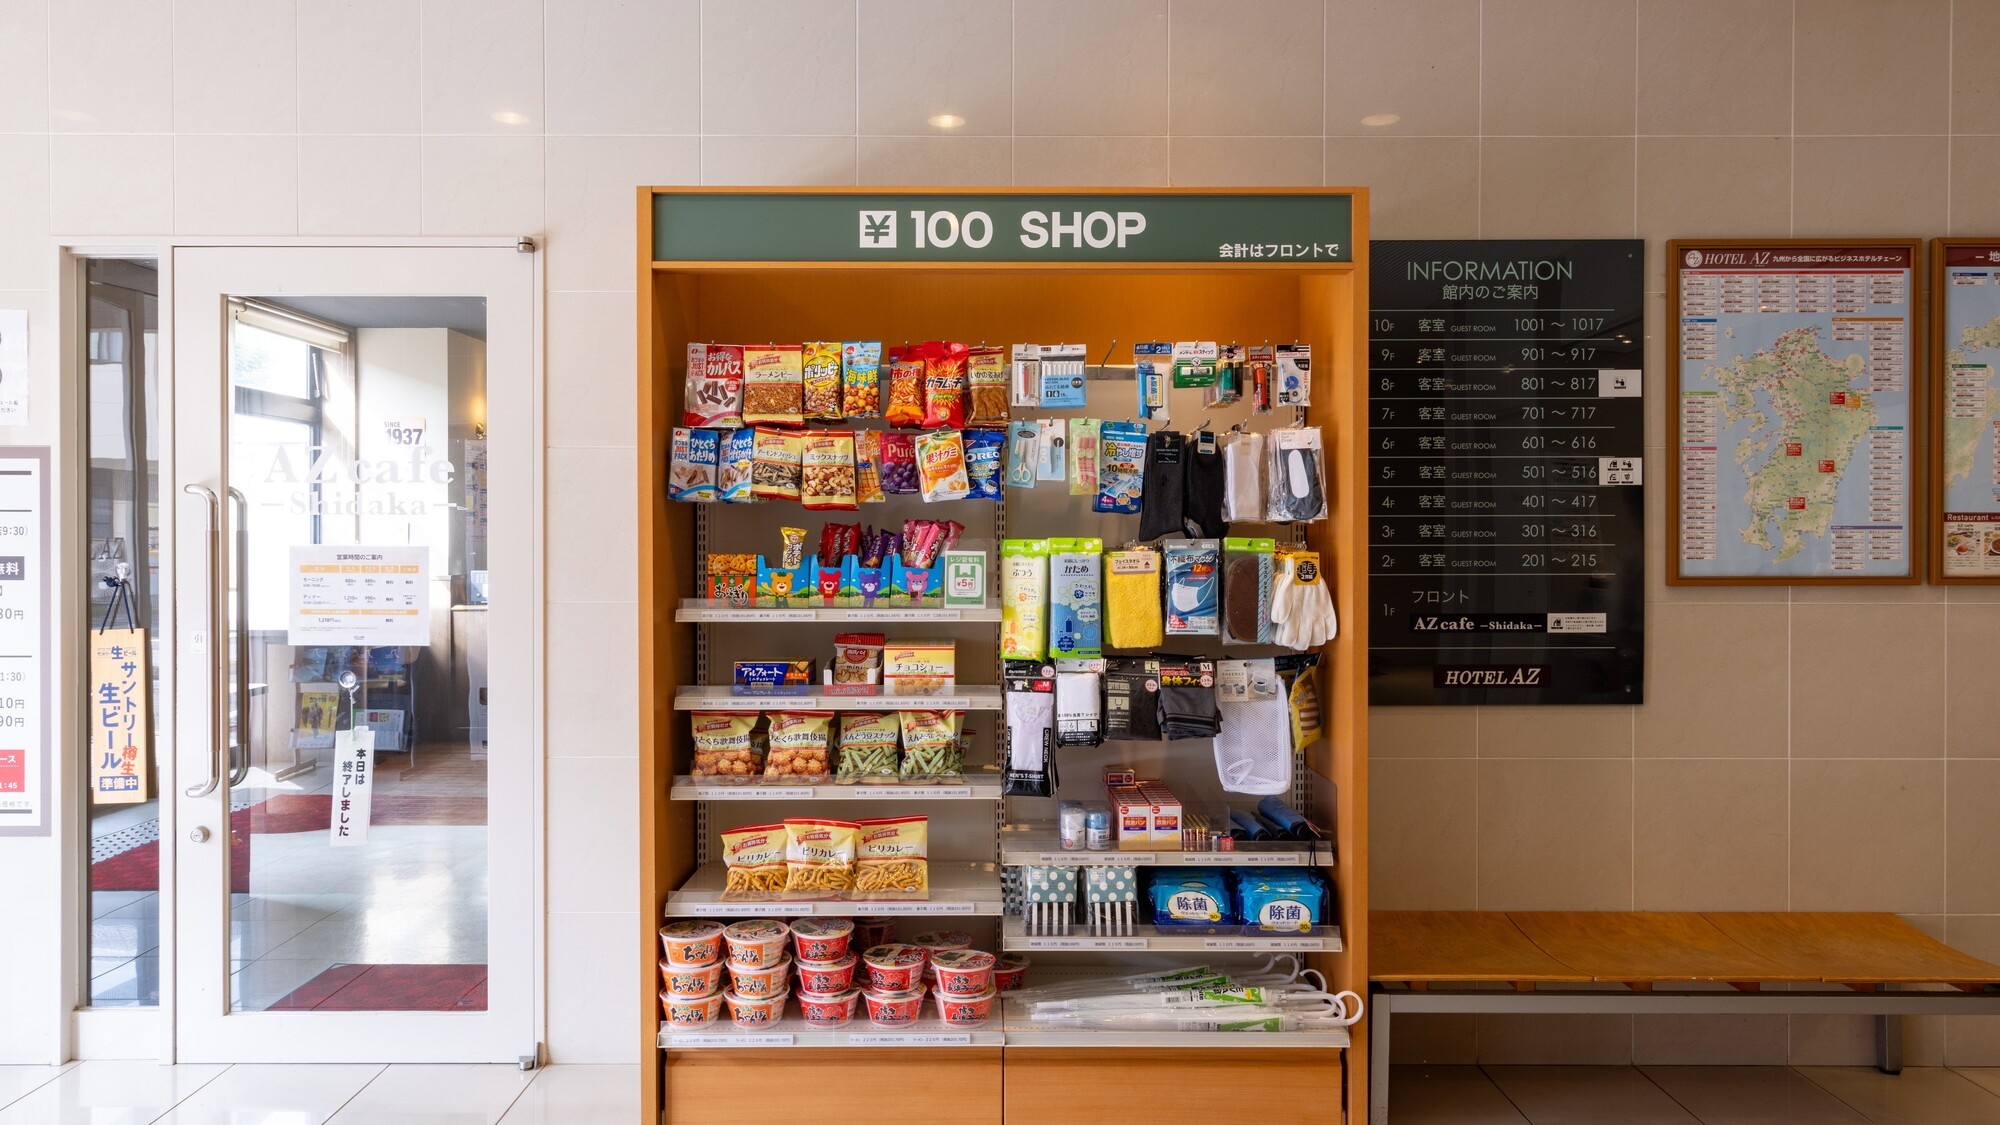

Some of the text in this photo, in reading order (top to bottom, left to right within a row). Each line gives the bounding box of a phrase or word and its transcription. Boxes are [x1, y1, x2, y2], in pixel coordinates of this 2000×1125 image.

[911, 210, 993, 249] 100
[1019, 210, 1147, 249] SHOP
[1218, 242, 1340, 258] 会計はフロントで
[1704, 252, 1902, 266] HOTEL AZ 九州から全国に広がるビジネスホテルチェーン
[1407, 260, 1573, 281] INFORMATION
[1442, 284, 1539, 300] 館内のご案内
[1374, 319, 1395, 332] 10F
[1418, 318, 1446, 332] 客室
[1514, 318, 1545, 332] 1001
[1572, 318, 1604, 331] 1017
[1382, 349, 1395, 362] 9F
[1418, 348, 1446, 362] 客室
[1522, 347, 1545, 361] 901
[1572, 347, 1596, 361] 917
[707, 360, 742, 376] カルパス
[804, 361, 839, 380] ポリッピー
[890, 368, 922, 380] 柿の種
[846, 368, 879, 385] 海味鮮
[1382, 378, 1395, 391] 8F
[1418, 377, 1446, 391] 客室
[1522, 377, 1545, 390] 801
[1572, 376, 1596, 390] 817
[1382, 407, 1395, 420] 7F
[1418, 406, 1446, 420] 客室
[1522, 406, 1545, 420] 701
[1572, 406, 1596, 420] 717
[385, 428, 423, 445] 1937
[690, 437, 716, 450] ひとくち
[1382, 437, 1395, 450] 6F
[1418, 436, 1446, 450] 客室
[1522, 435, 1545, 449] 601
[1572, 435, 1596, 449] 616
[689, 450, 716, 464] あたりめ
[888, 442, 916, 458] Puré
[925, 446, 959, 465] 果汁グミ
[964, 450, 1000, 462] OREO
[264, 446, 455, 485] AZ cafe
[1382, 466, 1395, 479] 5F
[1418, 465, 1446, 479] 客室
[1522, 465, 1545, 479] 501
[1572, 465, 1596, 478] 516
[1382, 496, 1395, 509] 4F
[1418, 495, 1446, 509] 客室
[1522, 494, 1545, 508] 401
[1572, 494, 1596, 508] 417
[1382, 525, 1395, 538] 3F
[1418, 524, 1446, 538] 客室
[1522, 524, 1545, 538] 301
[1572, 524, 1596, 537] 316
[1382, 555, 1395, 568] 2F
[1418, 554, 1446, 568] 客室
[1522, 553, 1545, 567] 201
[1572, 553, 1596, 567] 215
[1064, 565, 1089, 574] かため
[714, 583, 749, 605] おにぎり
[1412, 590, 1469, 604] フロント
[1383, 604, 1395, 616] 1F
[1414, 617, 1475, 631] AZ cafe
[742, 667, 783, 677] アルフォート
[895, 663, 944, 672] チョコシュー
[1444, 668, 1541, 686] HOTEL AZ
[121, 662, 137, 747] サントリー
[98, 682, 122, 770] 生ビール
[843, 732, 896, 741] えんどう豆スナック
[355, 748, 366, 785] 本日は
[101, 776, 138, 790] 準備中
[338, 760, 353, 837] 終了しました
[1176, 896, 1208, 912] 除菌
[1269, 904, 1302, 920] 除菌
